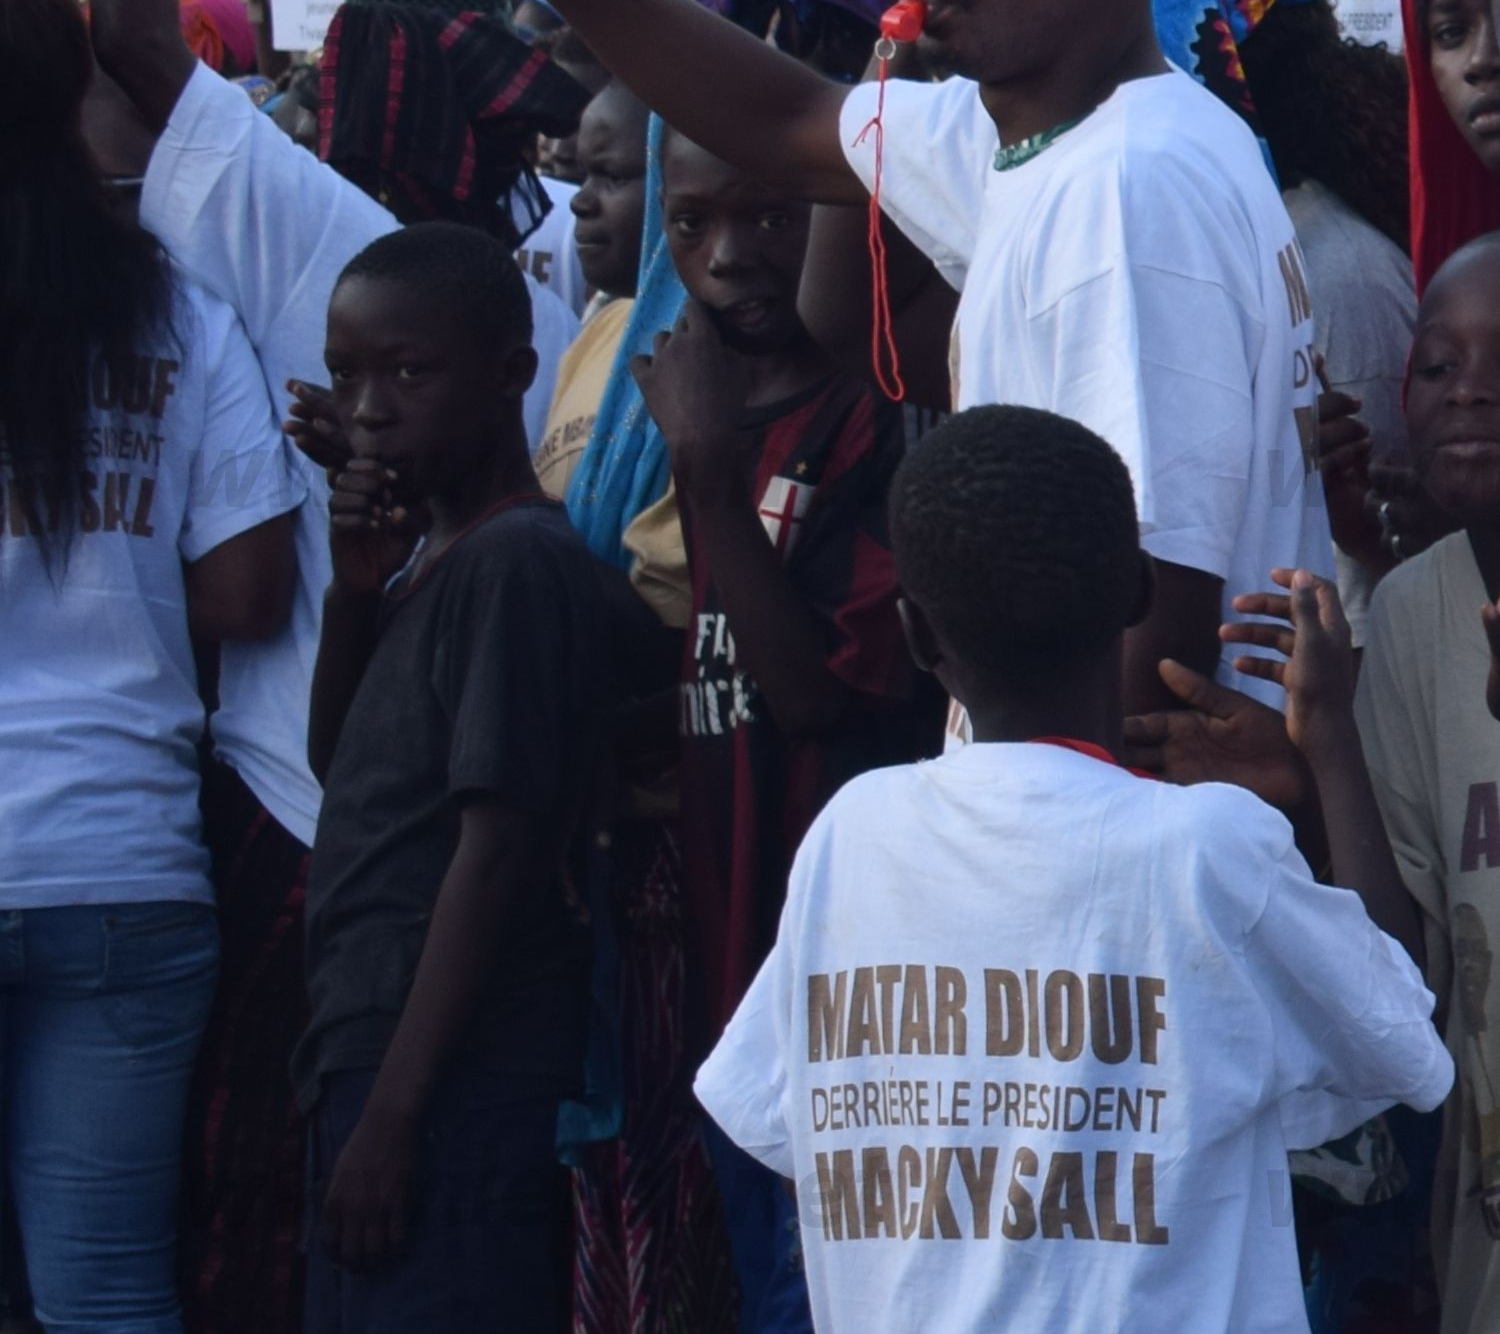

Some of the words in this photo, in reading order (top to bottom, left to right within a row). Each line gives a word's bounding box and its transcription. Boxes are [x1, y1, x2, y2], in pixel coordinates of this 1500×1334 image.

[807, 964, 968, 1064] MATAR
[984, 967, 1168, 1066] DIOUF
[937, 1081, 972, 1127] LE
[982, 1081, 1168, 1134] PRESIDENT
[814, 1144, 1000, 1242] MACKY
[1001, 1146, 1170, 1246] SALL
